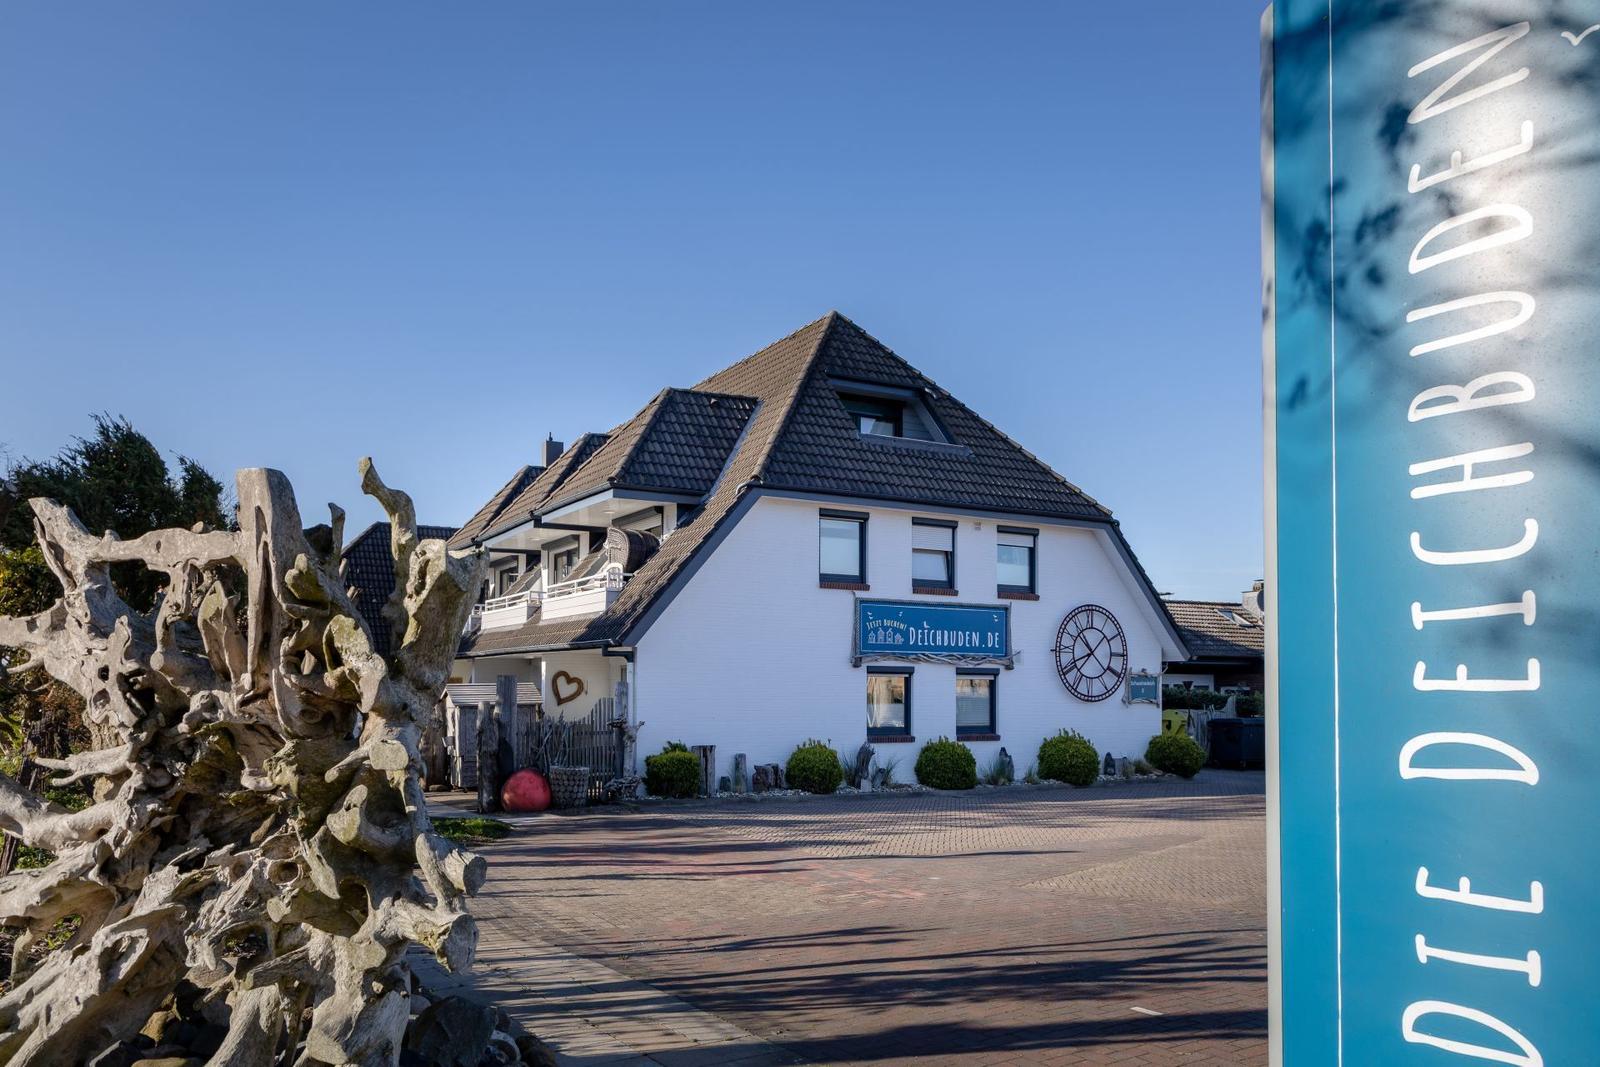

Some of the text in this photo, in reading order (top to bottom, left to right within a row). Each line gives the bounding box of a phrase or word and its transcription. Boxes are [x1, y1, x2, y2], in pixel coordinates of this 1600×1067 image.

[909, 627, 999, 648] DEICHBUDEN.DE
[1399, 20, 1544, 1067] DIE DEICHBUDEN
